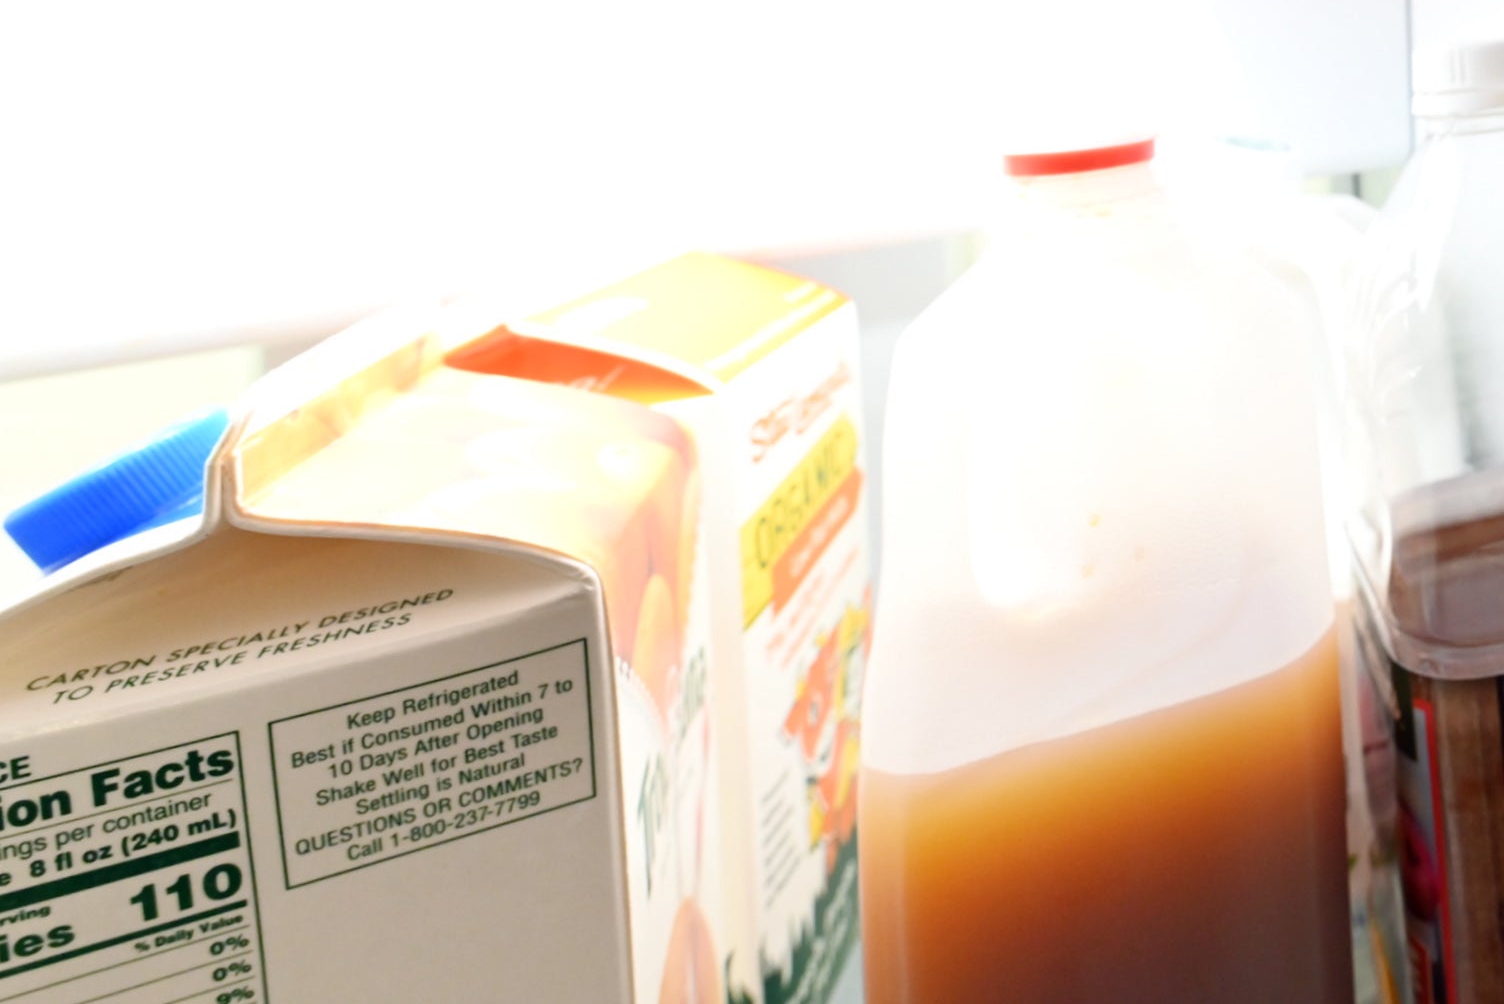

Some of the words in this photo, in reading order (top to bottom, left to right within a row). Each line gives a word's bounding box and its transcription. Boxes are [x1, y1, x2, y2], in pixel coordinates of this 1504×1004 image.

[25, 654, 155, 692] CARTON
[167, 621, 310, 662] SPECIALLY
[317, 588, 454, 629] DESIGNED
[52, 684, 93, 705] TO
[105, 651, 247, 693] PRESERVE
[256, 612, 412, 658] FRESHNESS
[291, 745, 335, 769] Best
[342, 738, 354, 756] if
[362, 712, 464, 750] Consumed
[471, 691, 532, 718] Within
[539, 684, 548, 699] 7
[556, 678, 573, 694] to
[347, 707, 395, 729] Keep
[403, 670, 518, 715] Refrigerated
[316, 779, 376, 806] Shake
[383, 764, 424, 787] Well
[431, 755, 455, 772] for
[465, 743, 504, 764] Best
[513, 726, 558, 749] Taste
[329, 760, 352, 779] 10
[360, 748, 408, 772] Days
[414, 734, 459, 755] After
[467, 708, 544, 742] Opening
[91, 749, 234, 807] Facts
[295, 809, 416, 856] QUESTIONS
[423, 800, 451, 819] OR
[459, 758, 583, 807] COMMENTS?
[356, 785, 429, 815] Settling
[437, 776, 452, 791] is
[459, 754, 525, 785] Natural
[30, 860, 46, 877] 8
[55, 852, 72, 871] fl
[83, 846, 113, 864] oz
[121, 825, 179, 856] (240
[188, 808, 236, 835] mL)
[55, 825, 95, 849] per
[102, 793, 212, 833] container
[347, 839, 383, 861] Call
[390, 791, 540, 848] 1-800-237-7799
[130, 863, 242, 922] 110
[155, 929, 194, 948] Daily
[199, 914, 243, 933] Value
[209, 934, 249, 956] 0%
[212, 959, 252, 982] 0%
